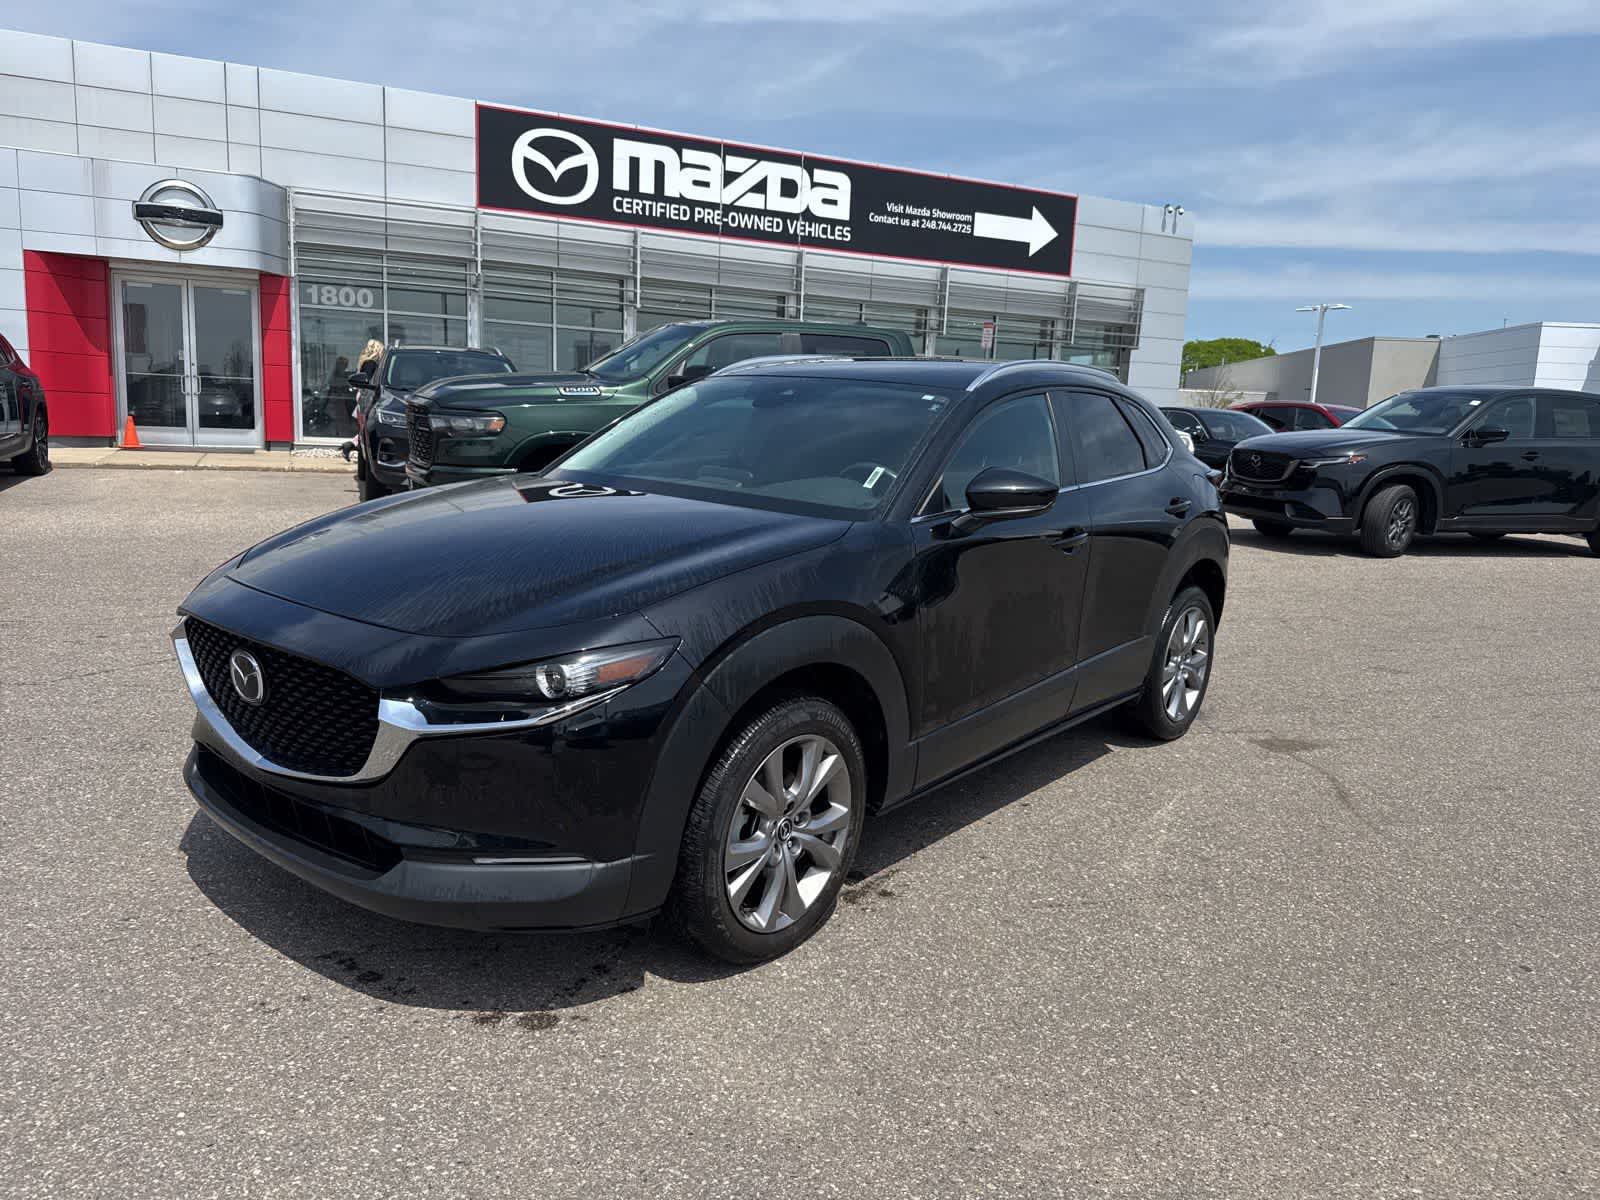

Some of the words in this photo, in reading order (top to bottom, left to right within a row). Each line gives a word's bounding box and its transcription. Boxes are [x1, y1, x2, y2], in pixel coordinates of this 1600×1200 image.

[612, 196, 691, 221] CERTIFIED
[694, 207, 783, 233] PRE-OWNED
[786, 219, 852, 241] VEHICLES
[868, 212, 899, 225] Contact
[900, 218, 910, 226] us
[911, 219, 920, 228] at
[921, 219, 972, 234] 248.744.2725
[886, 202, 904, 214] Visit
[905, 205, 931, 217] Mazda
[931, 208, 973, 223] Showroom
[306, 284, 374, 308] 1800
